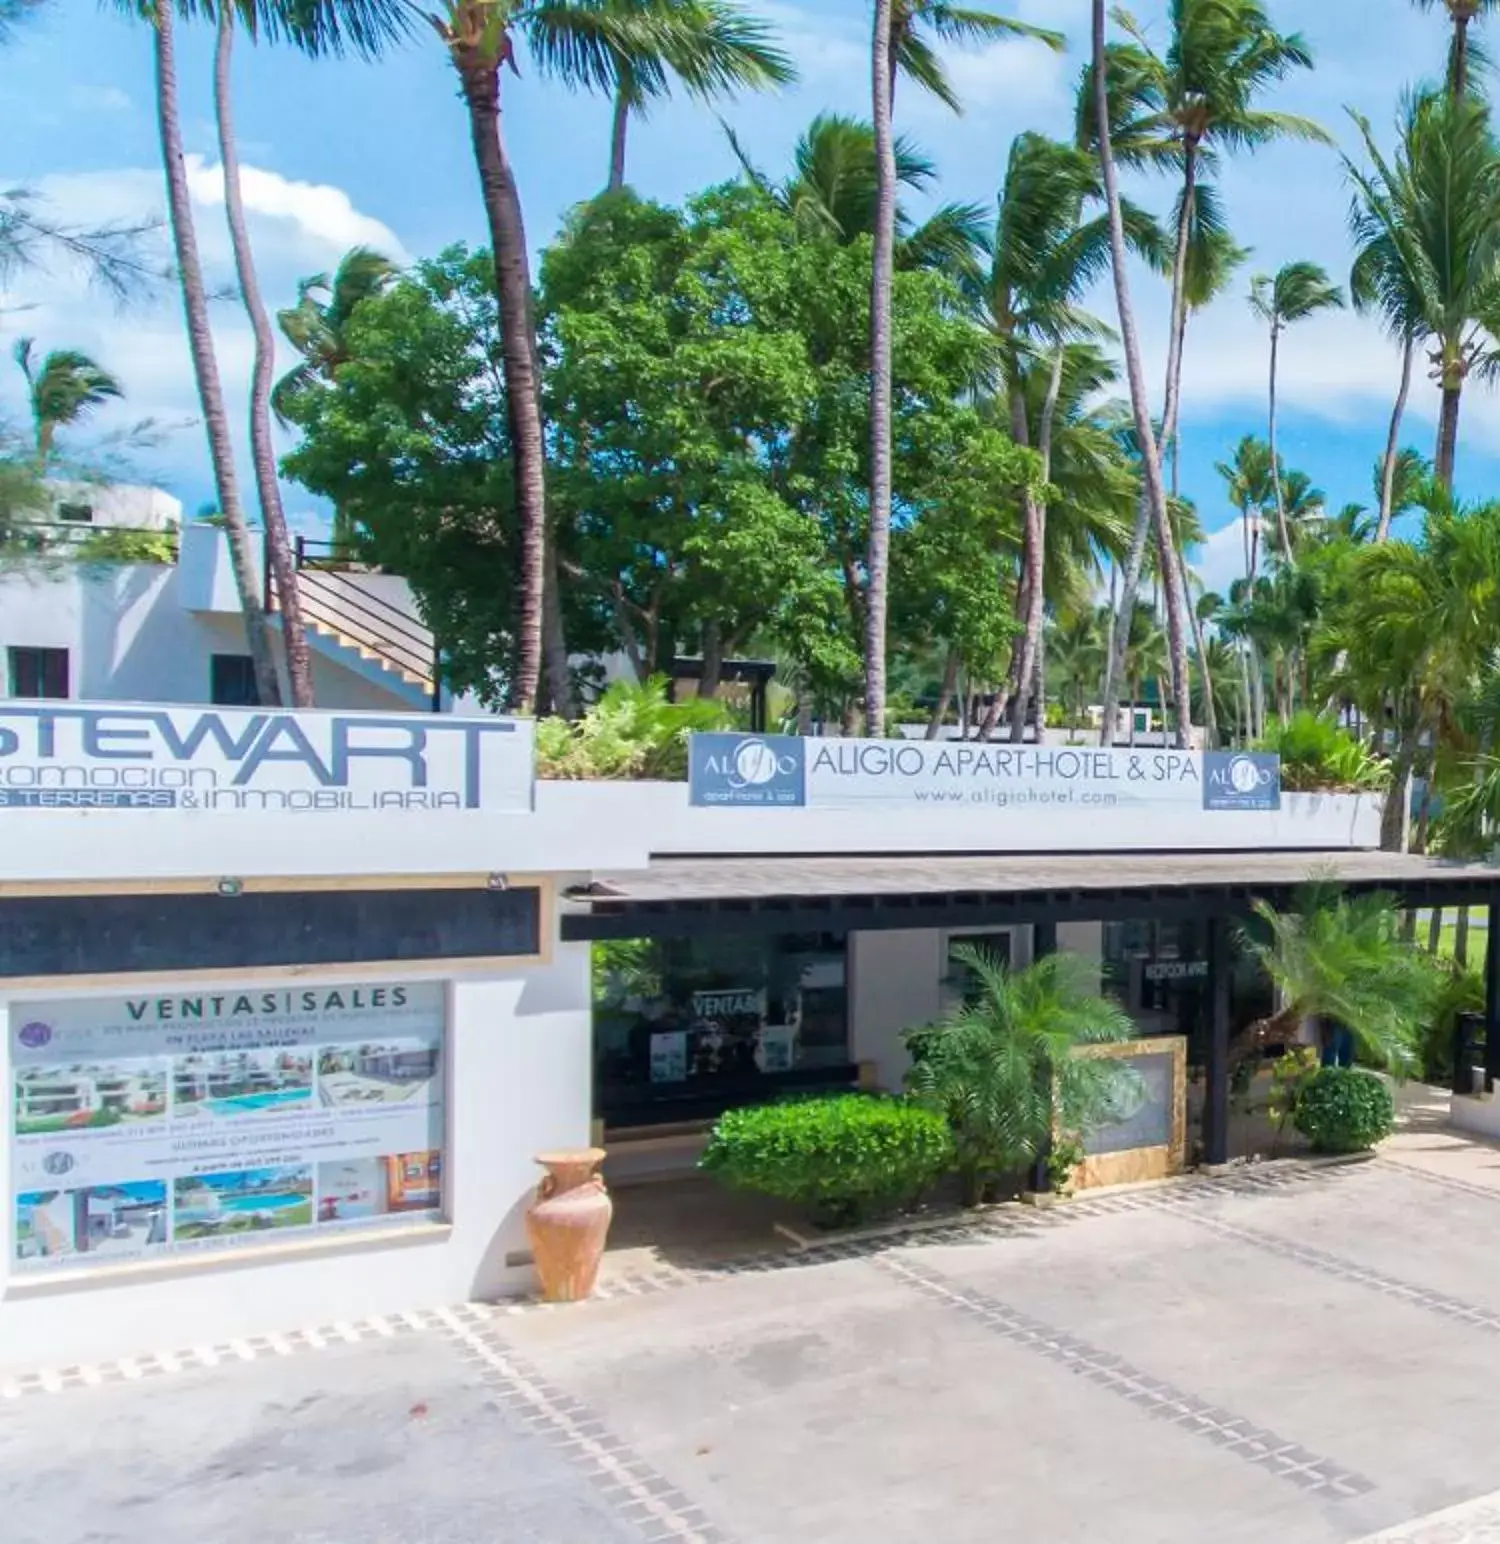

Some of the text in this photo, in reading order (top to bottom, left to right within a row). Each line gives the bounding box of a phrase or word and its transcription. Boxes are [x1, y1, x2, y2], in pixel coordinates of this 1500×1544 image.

[811, 745, 1199, 781] ALIGIO APART-HOTEL & SPA
[914, 785, 1117, 807] www.aligiohotel.com
